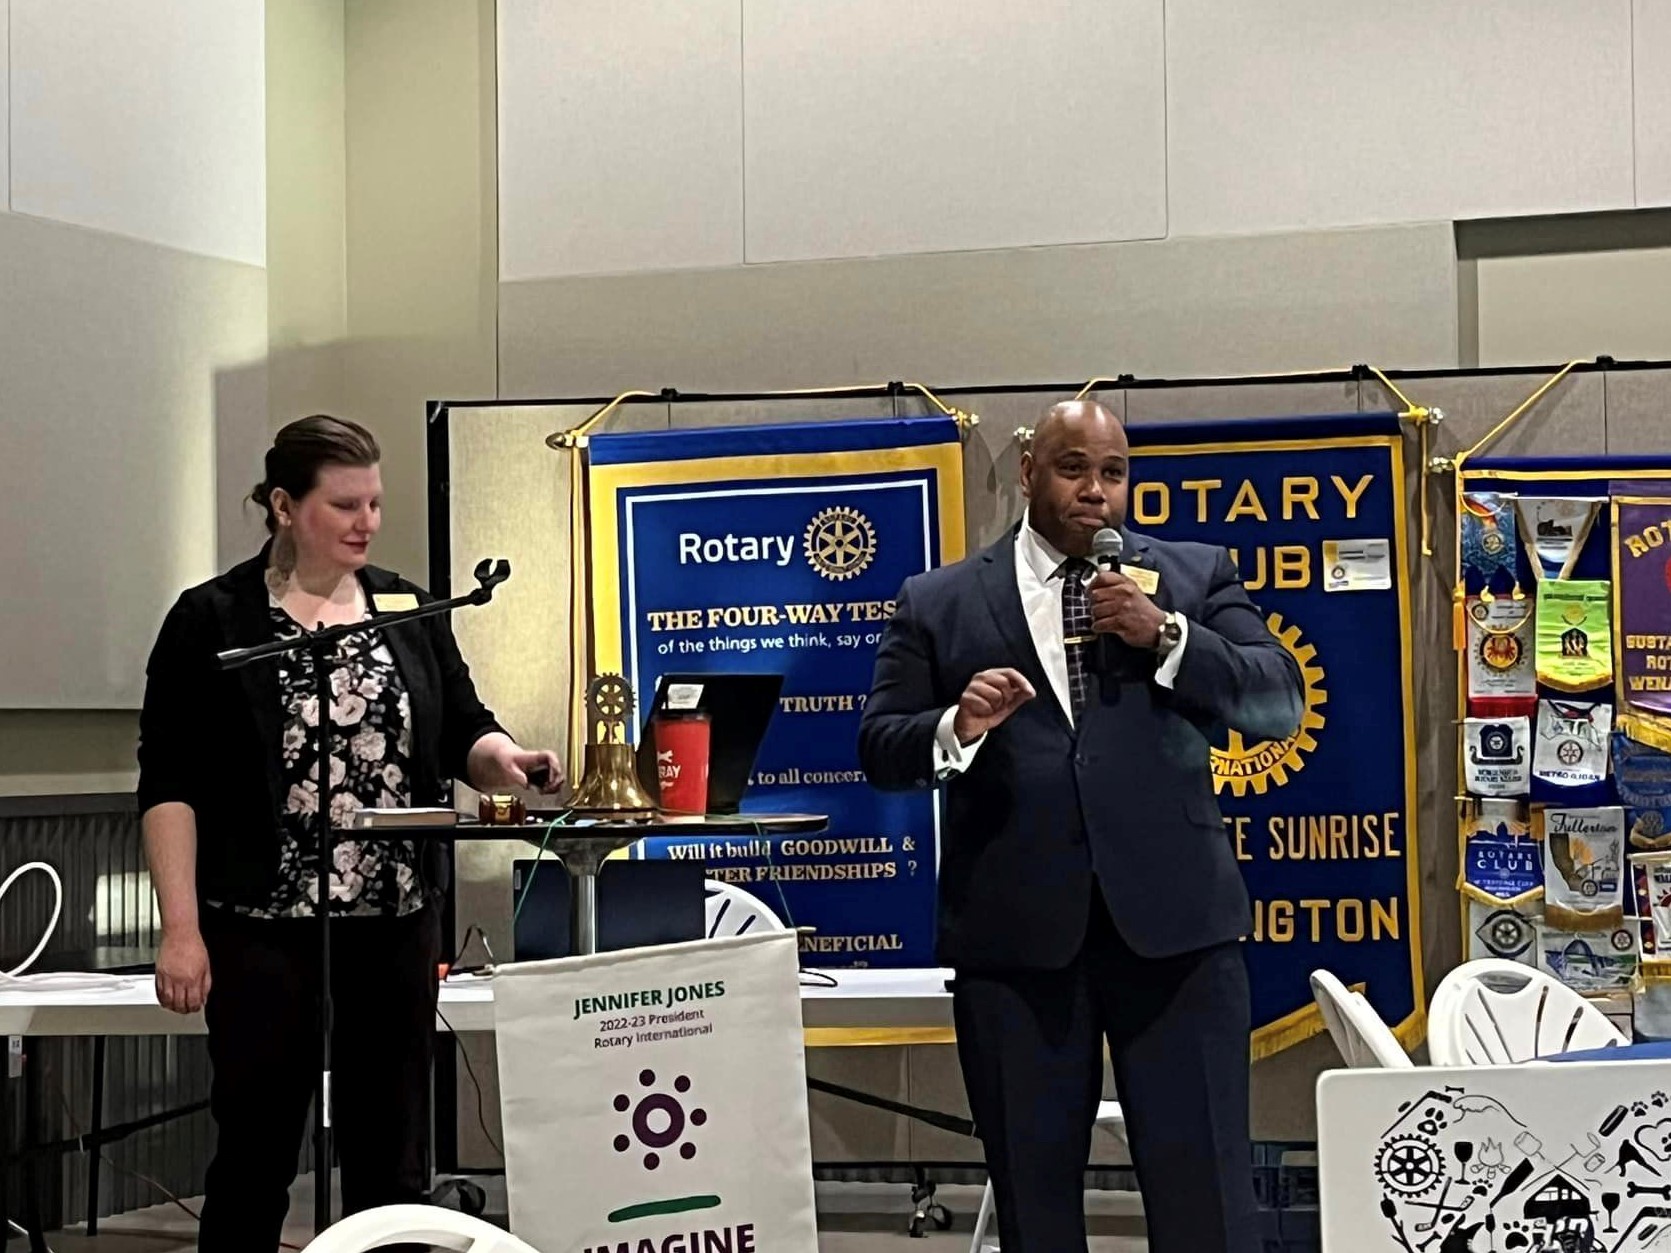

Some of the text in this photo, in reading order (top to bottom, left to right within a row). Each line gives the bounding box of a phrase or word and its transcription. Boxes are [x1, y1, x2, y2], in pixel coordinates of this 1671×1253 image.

[1133, 474, 1375, 525] OTARY
[679, 533, 795, 566] Rotary
[1228, 547, 1311, 591] UB
[647, 600, 897, 631] THE FOUR-WAY TES
[658, 632, 882, 655] of the things we think, say or
[780, 694, 868, 712] TRUTH ?
[757, 772, 776, 785] to
[779, 768, 801, 785] all
[666, 835, 916, 860] Will it build GOODWILL &
[1268, 812, 1401, 860] SUNRISE
[705, 860, 918, 882] TER FRIENDSHIPS ?
[573, 980, 725, 1020] JENNIFER JONES
[600, 1009, 705, 1032] 2022-23 President
[594, 1023, 713, 1049] Rotary International
[584, 1223, 755, 1253] GINE
